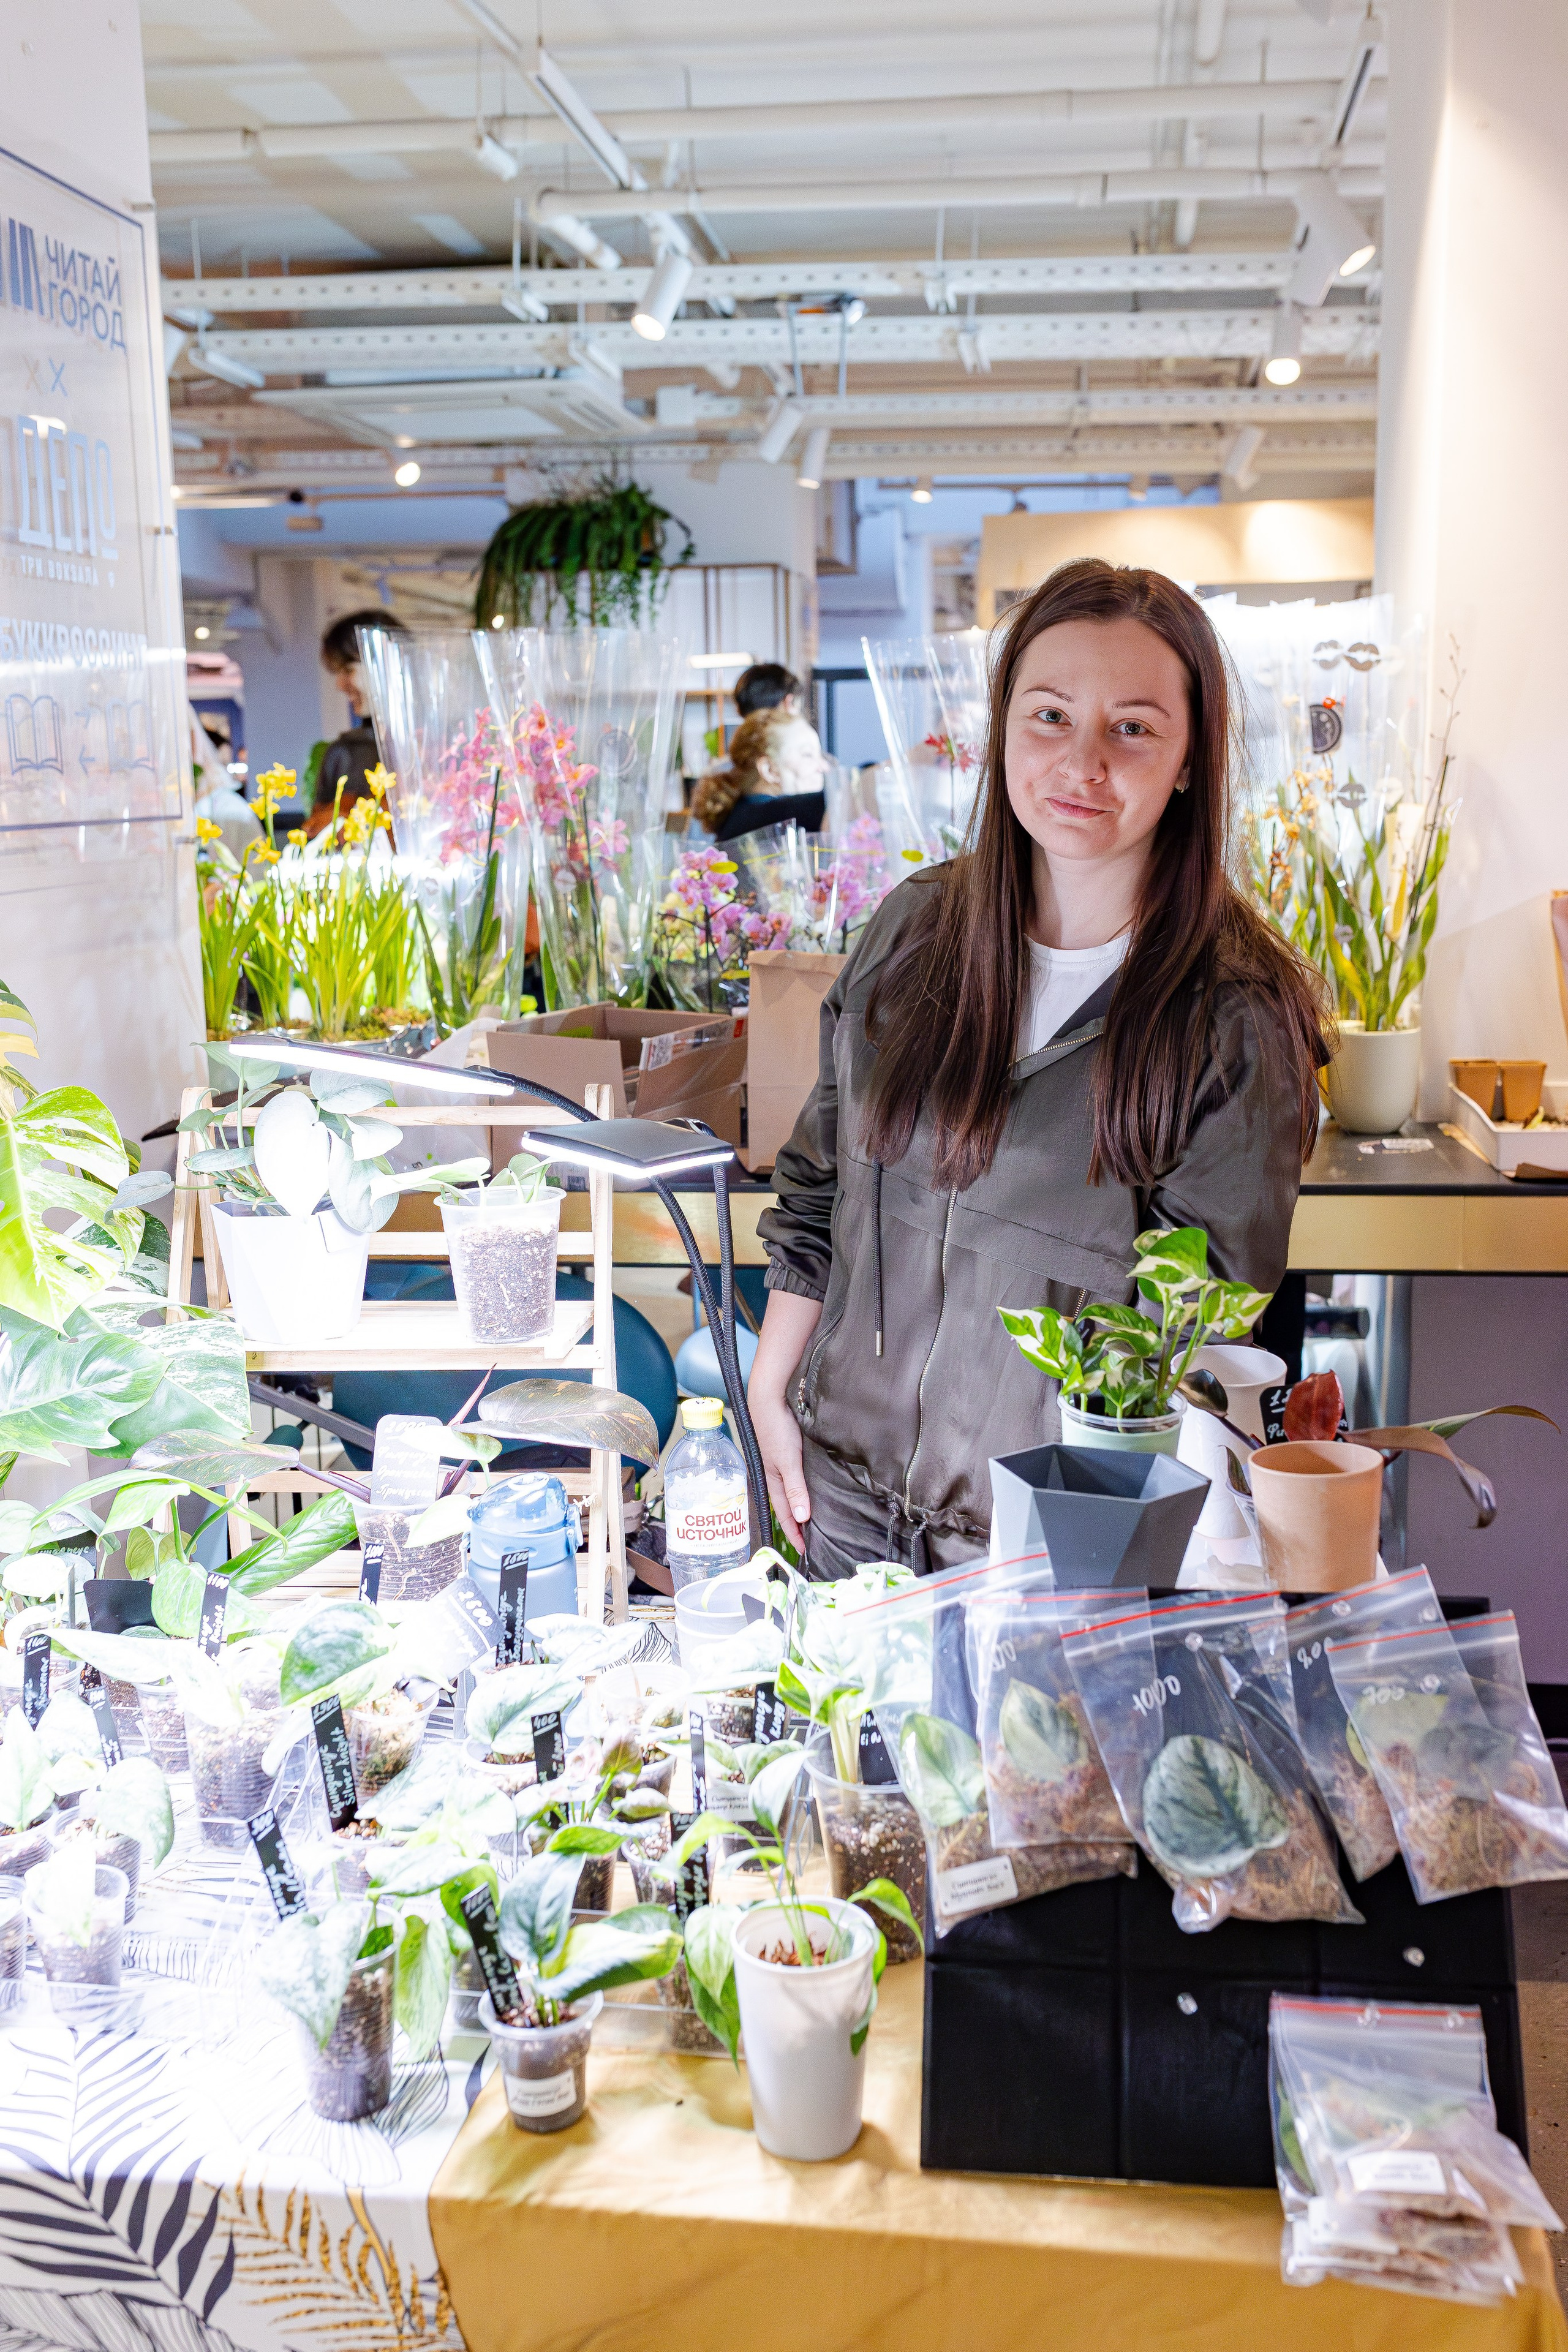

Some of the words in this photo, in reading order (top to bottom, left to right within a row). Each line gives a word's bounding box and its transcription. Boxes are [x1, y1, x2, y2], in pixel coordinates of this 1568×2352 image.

[45, 235, 123, 306] ЧИТАЙ
[48, 281, 127, 357] ГОРОД
[18, 415, 118, 560] ДЕПО
[677, 1520, 747, 1540] ИСТОЧНИК
[685, 1507, 742, 1526] СВЯТОЙ
